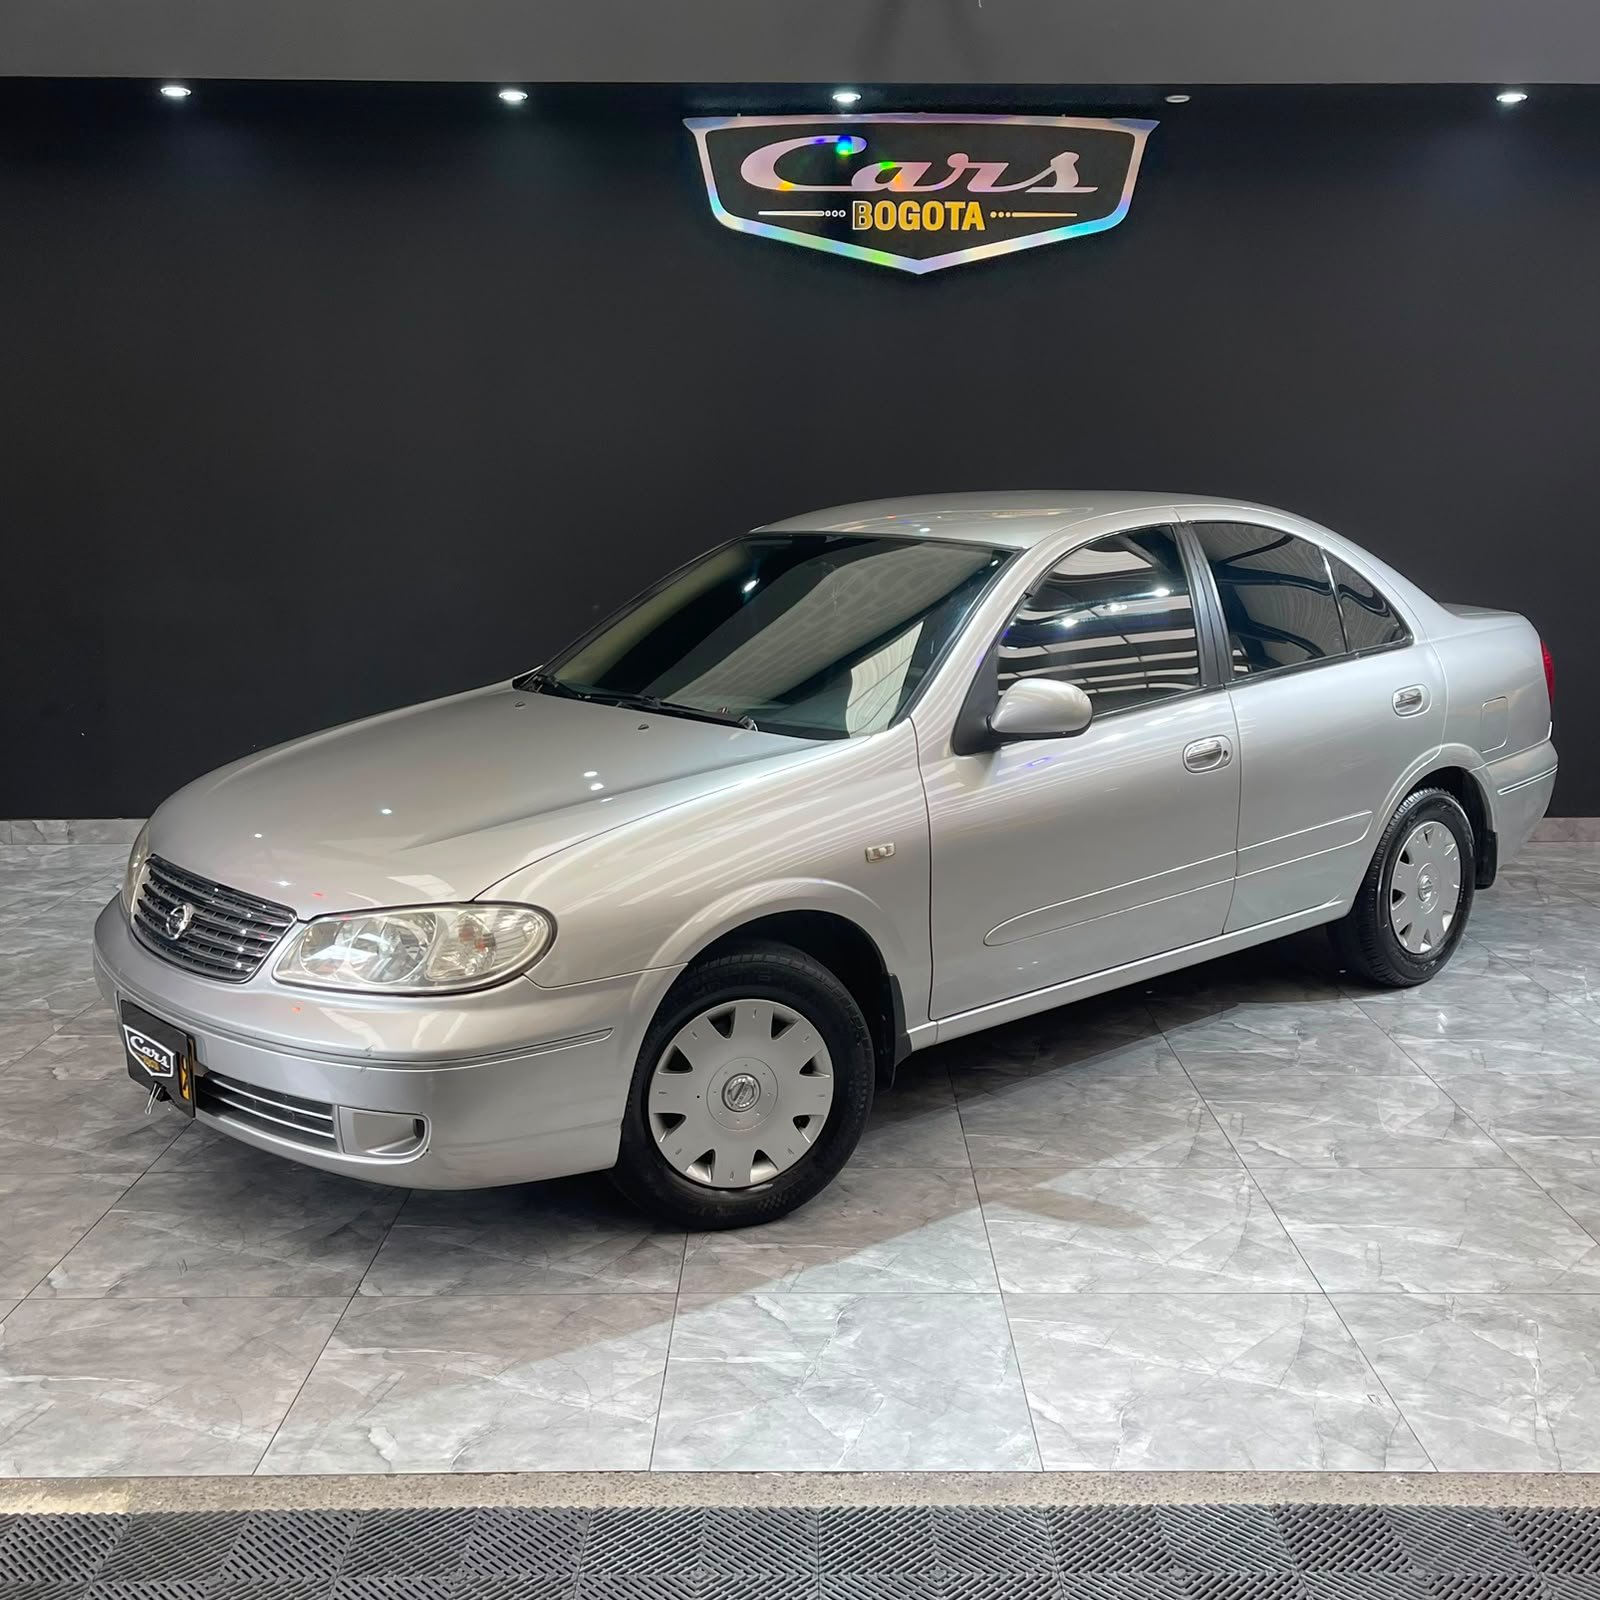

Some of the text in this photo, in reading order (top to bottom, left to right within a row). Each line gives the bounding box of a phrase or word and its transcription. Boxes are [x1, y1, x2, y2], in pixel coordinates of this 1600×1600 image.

[740, 135, 1098, 193] Cars
[852, 200, 986, 232] BOGOTA
[130, 1035, 170, 1069] Cars
